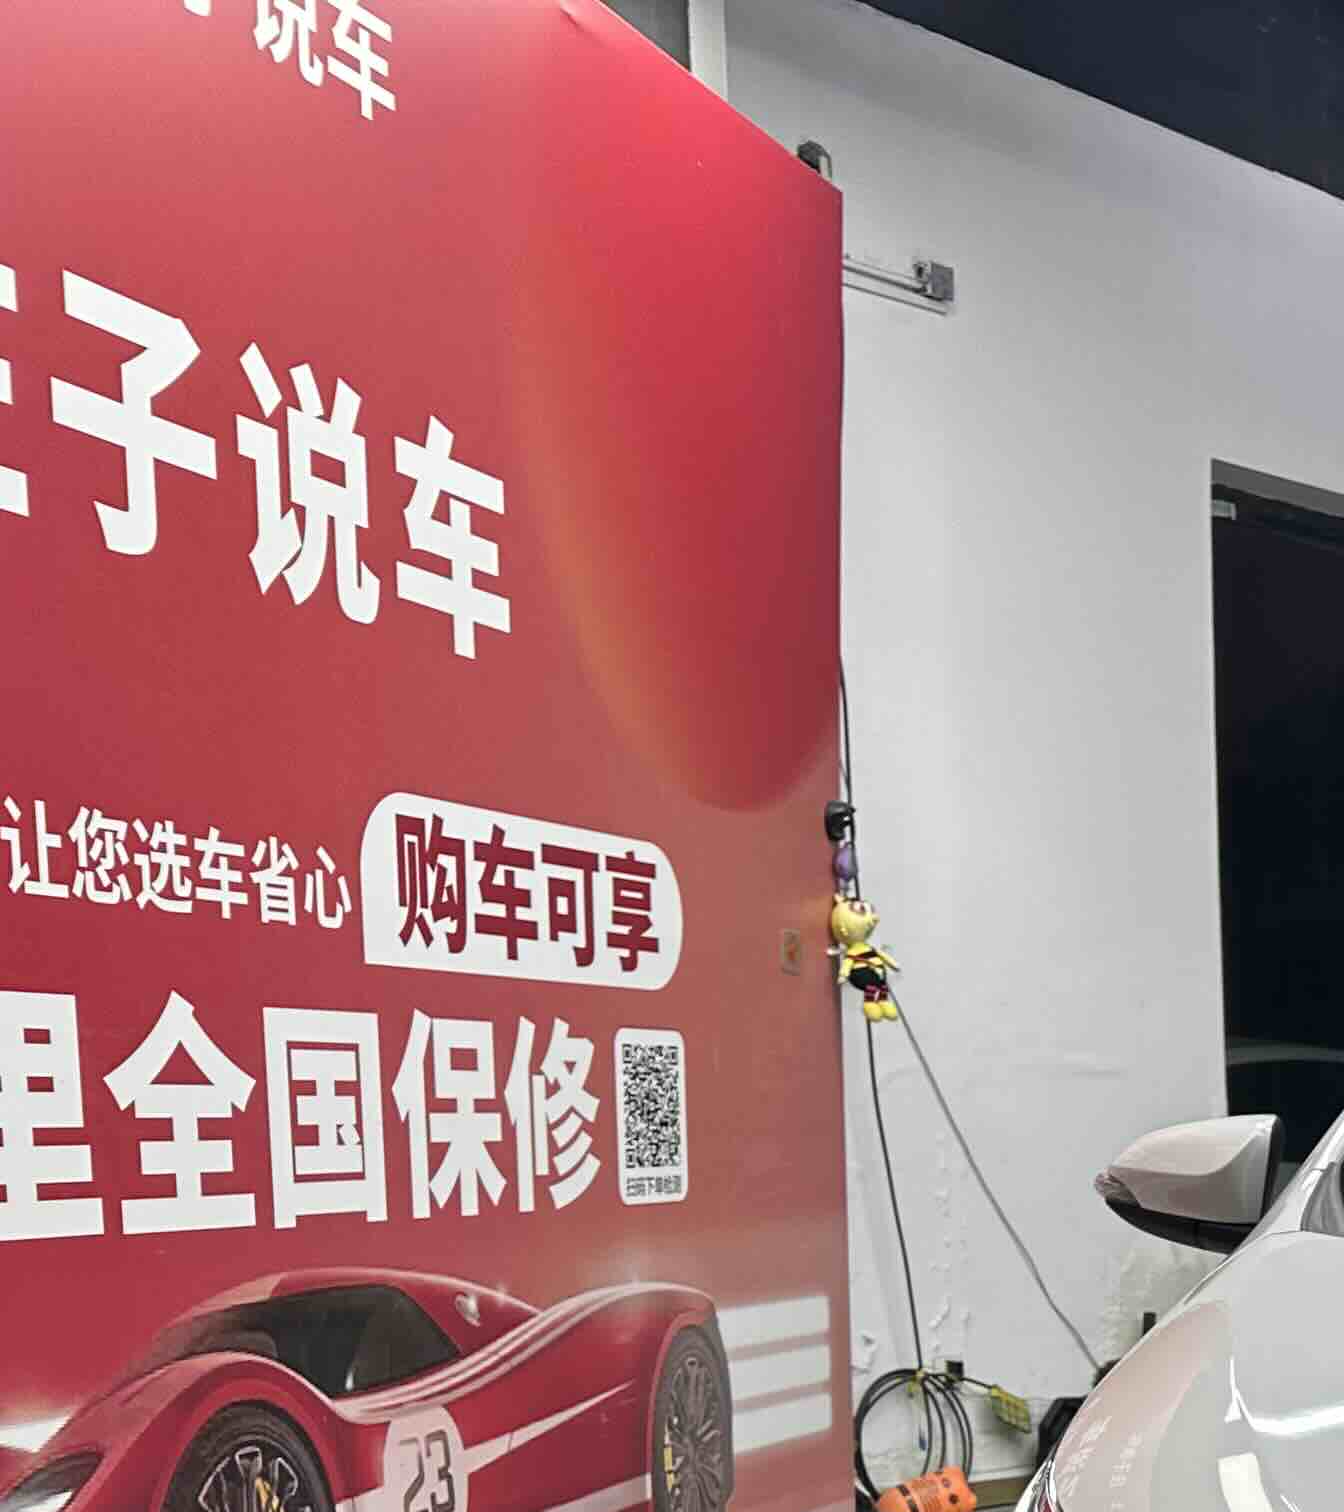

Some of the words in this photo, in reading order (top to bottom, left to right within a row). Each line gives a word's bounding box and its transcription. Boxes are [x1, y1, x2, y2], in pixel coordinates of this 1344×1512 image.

[184, 0, 397, 120] 说车
[0, 263, 511, 660] 子说车
[0, 796, 352, 928] 让您选车省心
[395, 814, 659, 972] 购车可享
[0, 990, 601, 1241] 里全国保修
